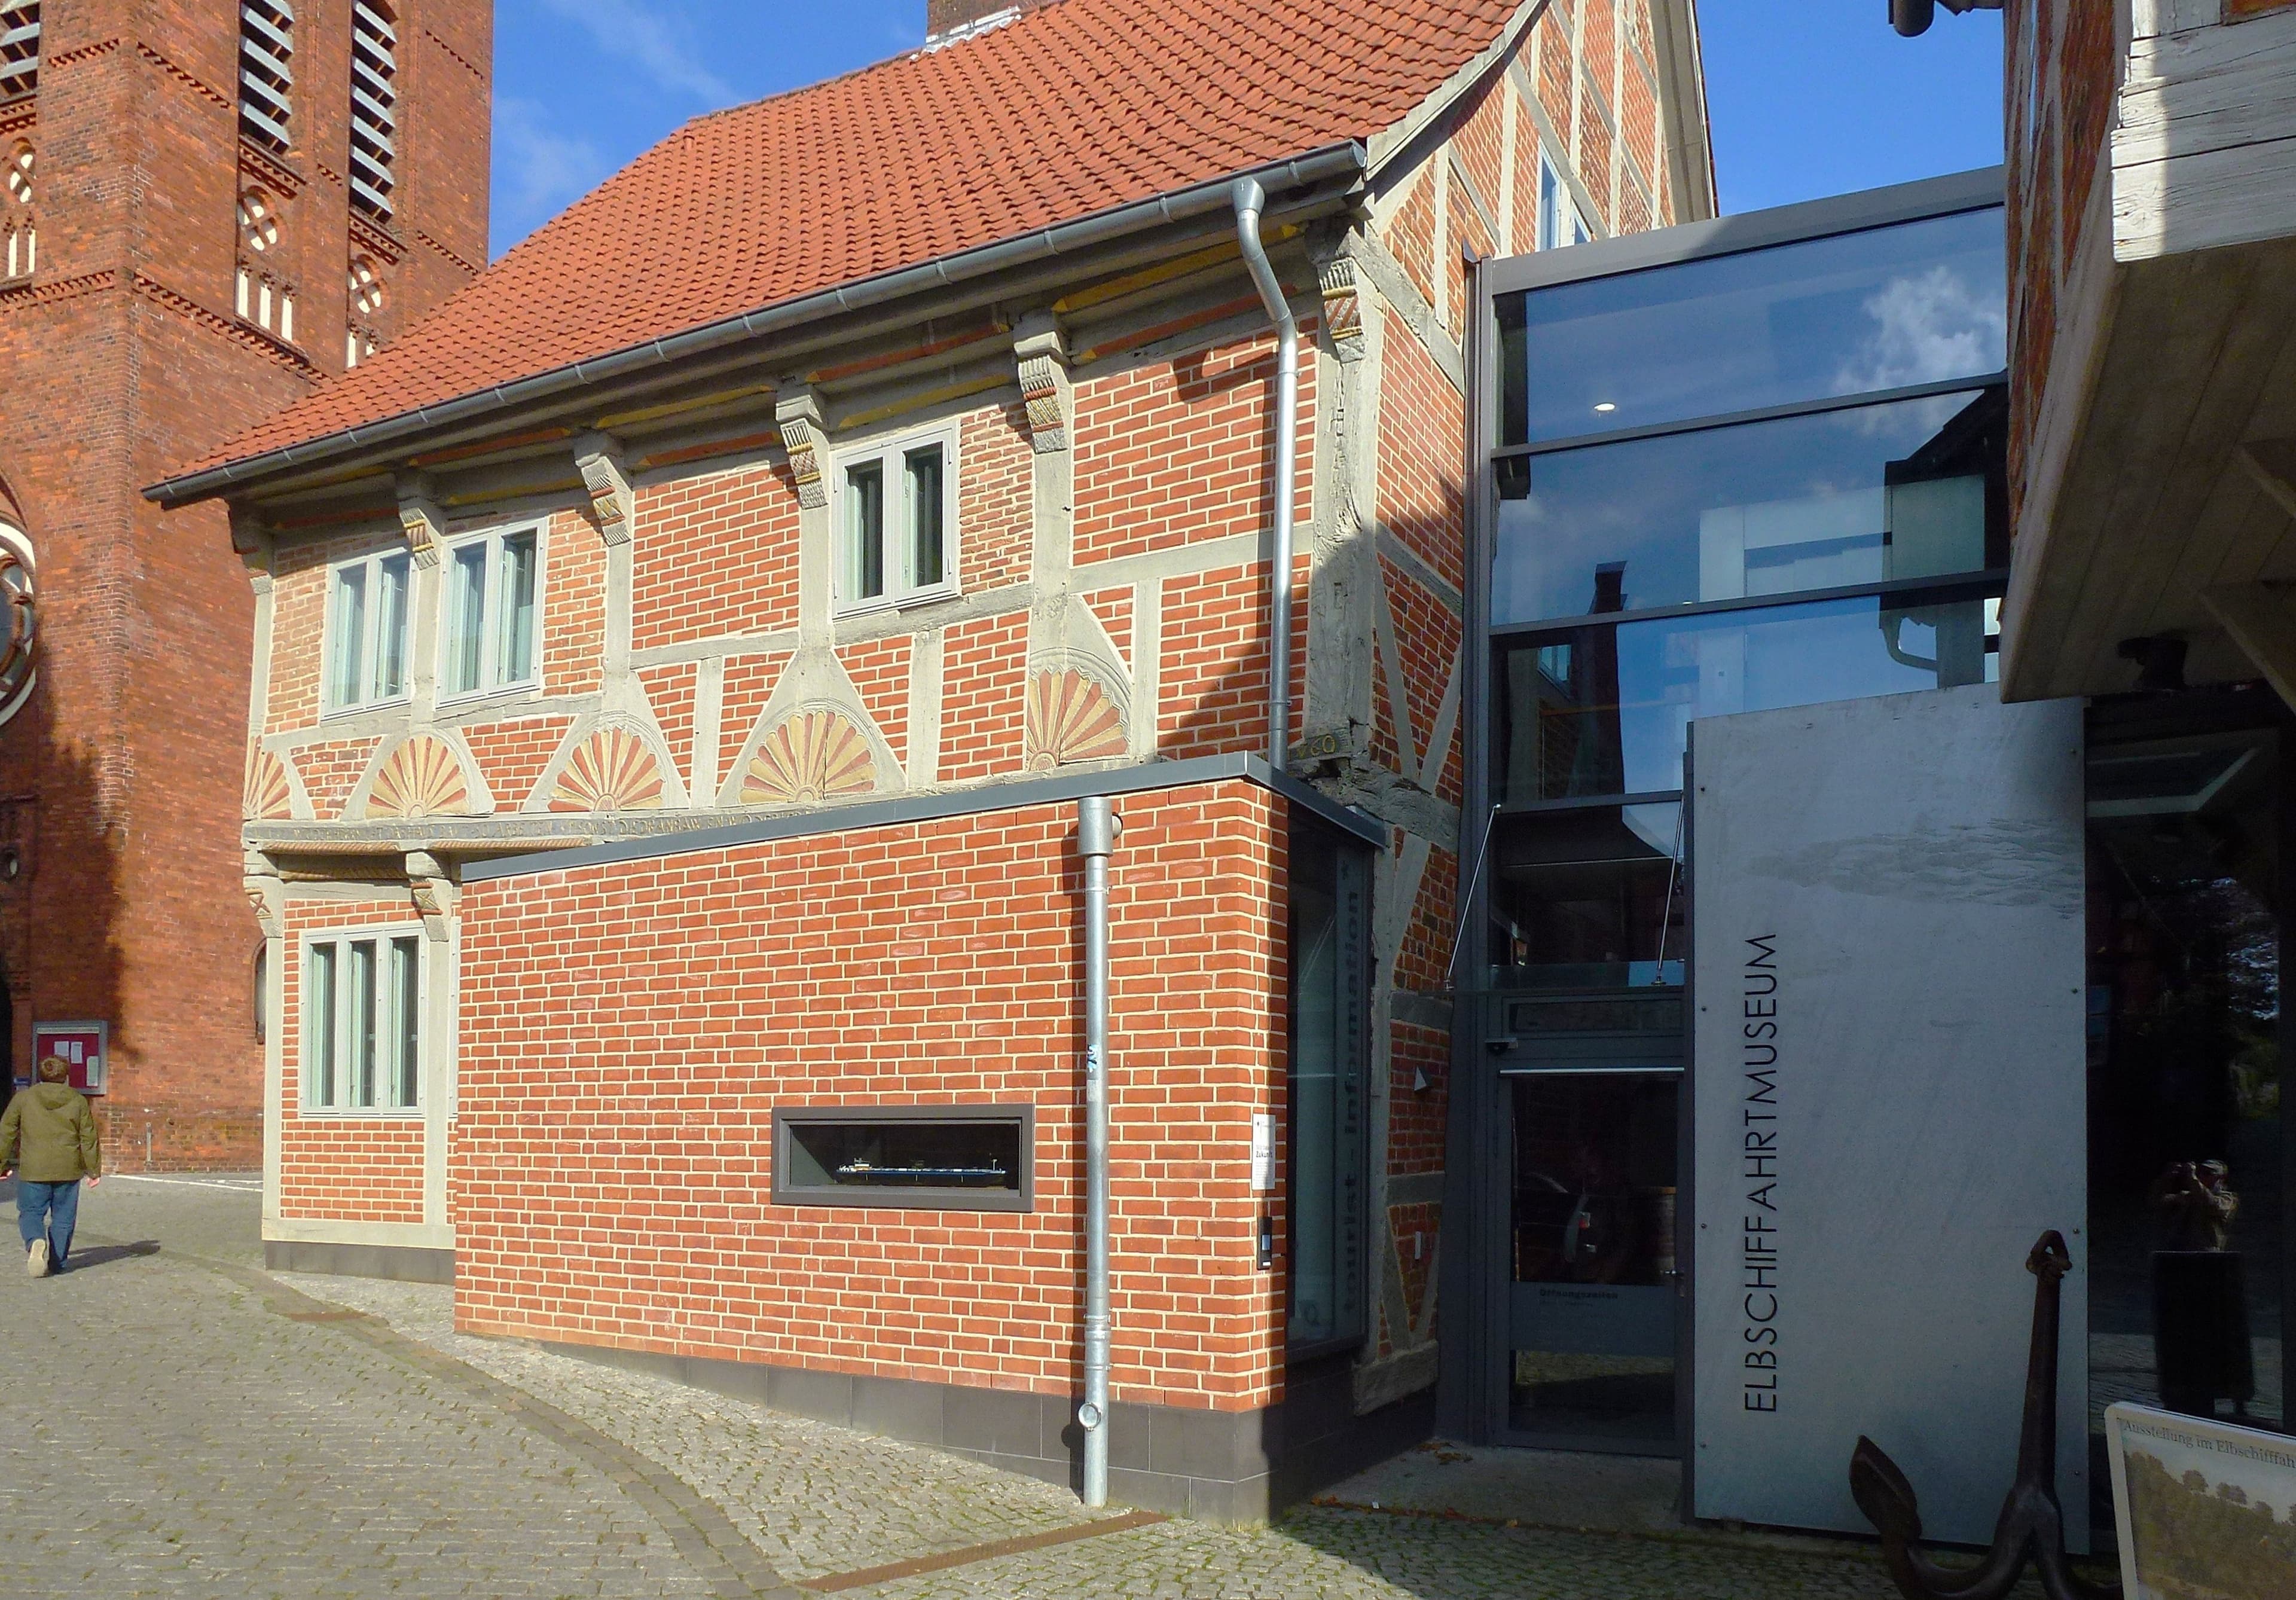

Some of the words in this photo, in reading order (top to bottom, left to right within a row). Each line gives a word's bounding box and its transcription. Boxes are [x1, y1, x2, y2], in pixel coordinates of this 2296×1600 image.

[1744, 934, 1778, 1412] ELBSCHIFFAHRTMUSEUM
[2124, 1420, 2193, 1448] Ausstellung
[2196, 1434, 2213, 1450] im
